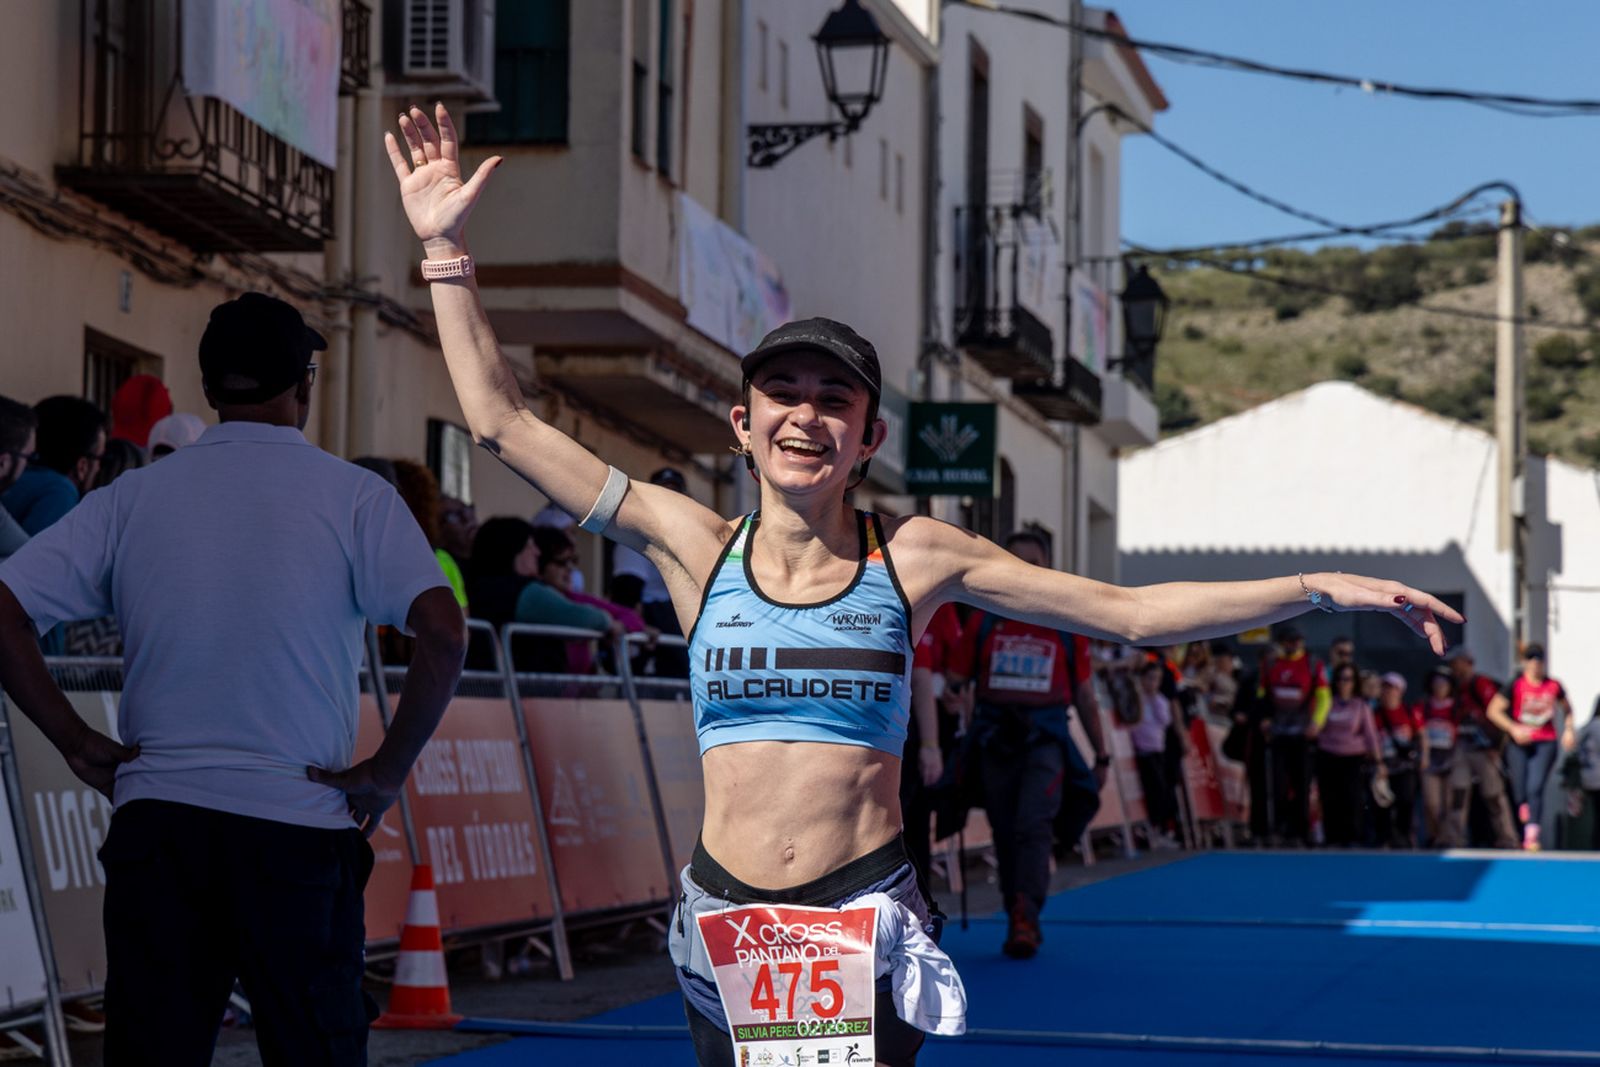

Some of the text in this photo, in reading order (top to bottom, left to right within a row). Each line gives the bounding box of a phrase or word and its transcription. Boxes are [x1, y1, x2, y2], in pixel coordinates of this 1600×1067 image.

[832, 613, 881, 626] MARATHON
[707, 679, 892, 702] ALCAUDETE
[426, 825, 465, 884] DEL
[725, 915, 758, 948] X
[759, 921, 843, 946] CROSS
[735, 943, 841, 969] PANTANO DEL
[750, 959, 844, 1021] 475
[738, 1026, 769, 1040] SILVIA
[769, 1025, 798, 1038] PEREZ
